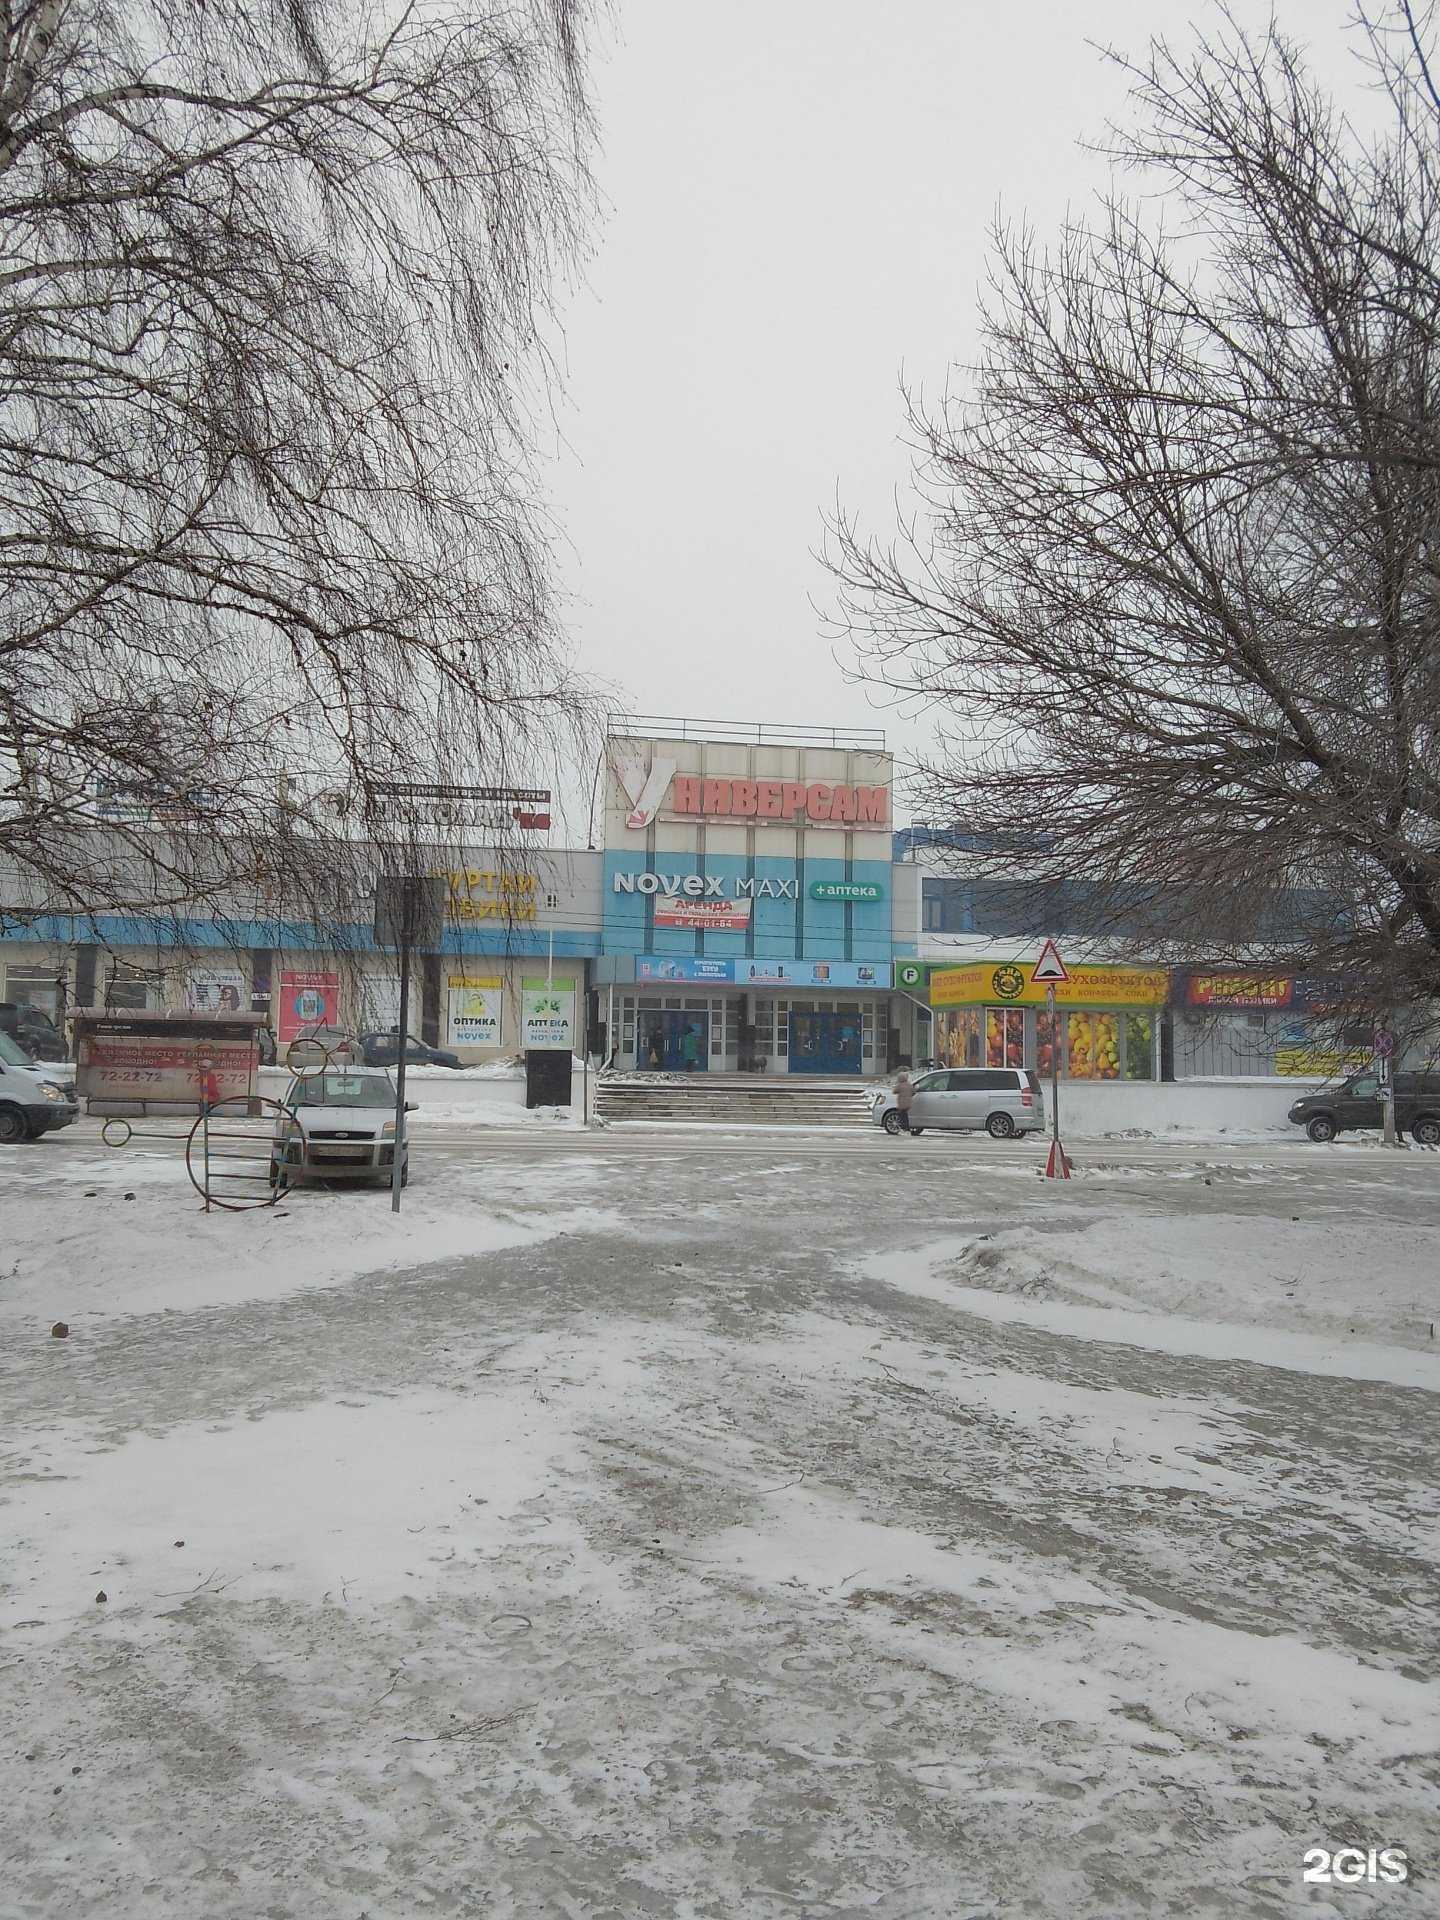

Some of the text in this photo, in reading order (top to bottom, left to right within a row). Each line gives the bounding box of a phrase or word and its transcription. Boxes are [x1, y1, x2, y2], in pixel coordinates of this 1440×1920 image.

[735, 878, 799, 899] MAXI
[675, 900, 733, 912] АРЕНДА
[906, 970, 914, 981] F
[453, 1017, 496, 1026] ОПТИКА
[527, 1019, 569, 1027] АПТЕКА
[100, 1071, 162, 1082] 72-22-72
[186, 1072, 247, 1084] 722-72
